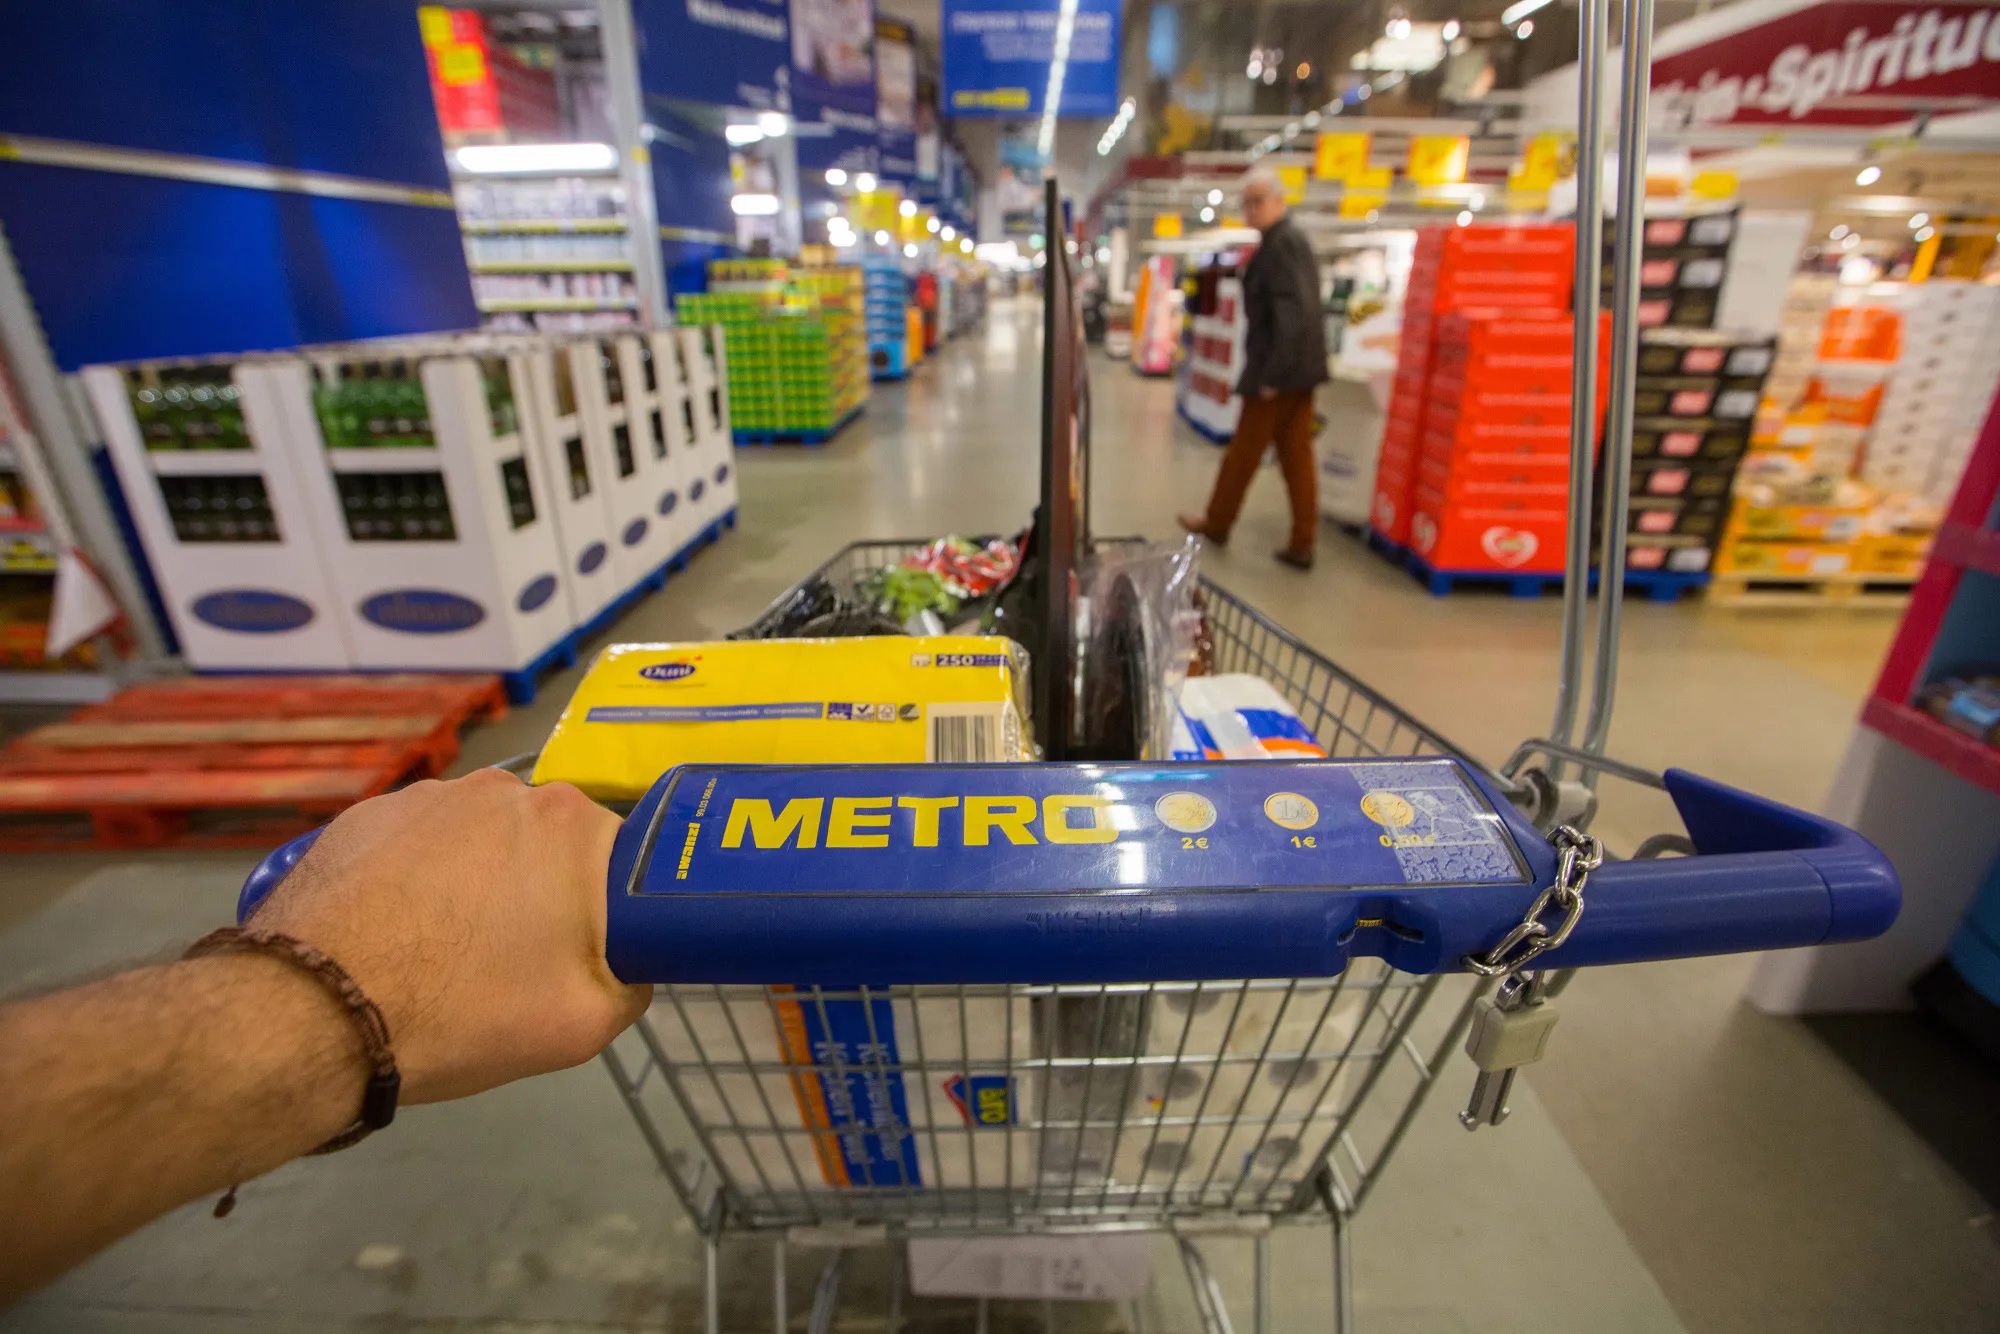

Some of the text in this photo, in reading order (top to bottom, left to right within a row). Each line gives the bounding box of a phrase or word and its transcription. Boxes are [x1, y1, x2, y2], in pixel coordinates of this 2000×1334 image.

[938, 655, 975, 666] 250
[645, 664, 692, 678] Duni
[721, 796, 1121, 848] METRO
[1181, 837, 1209, 850] 2€
[1290, 835, 1317, 849] 1€
